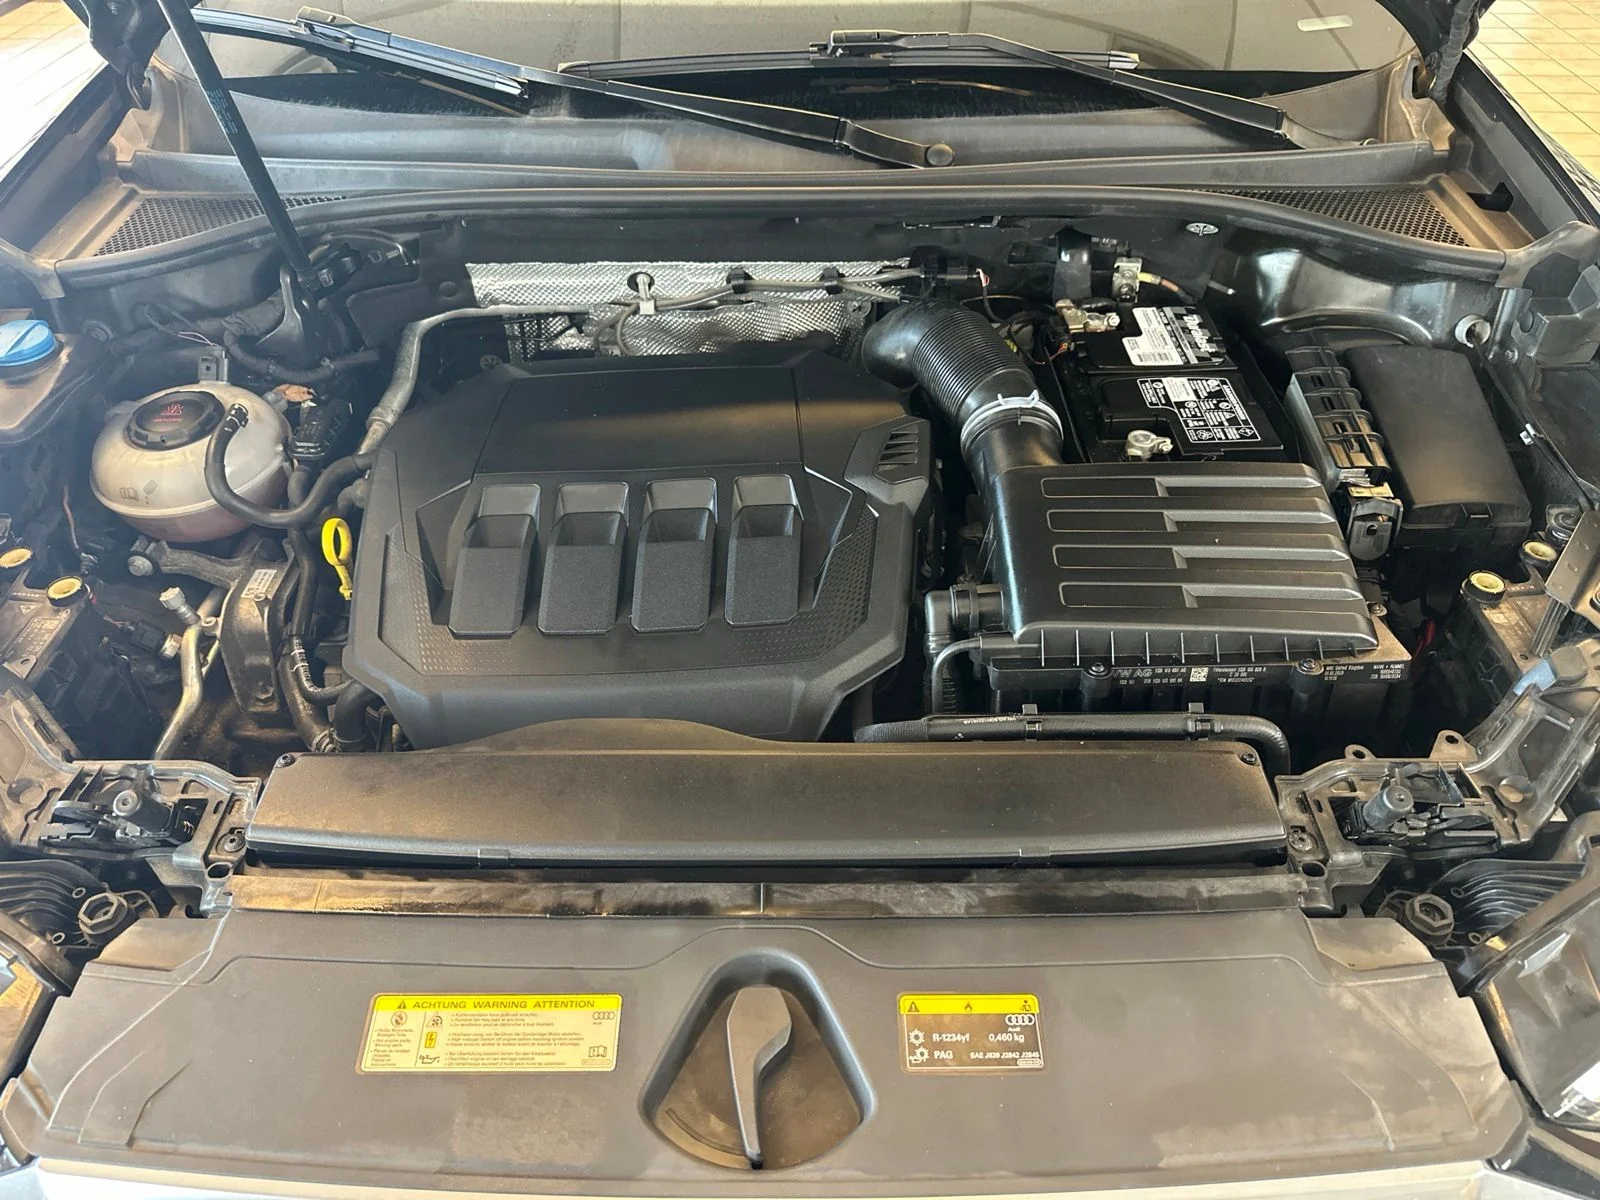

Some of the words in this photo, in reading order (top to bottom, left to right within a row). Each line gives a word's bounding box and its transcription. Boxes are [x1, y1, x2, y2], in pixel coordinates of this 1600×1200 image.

[1182, 314, 1216, 353] Duralast
[1133, 668, 1153, 677] AG
[412, 1001, 467, 1009] ACHTUNG
[472, 1001, 528, 1009] WARNING
[533, 1000, 595, 1009] ATTENTION
[932, 1033, 970, 1043] R-1234yf
[988, 1033, 1012, 1043] 0,460
[1013, 1033, 1025, 1043] kg
[933, 1050, 953, 1059] PAG
